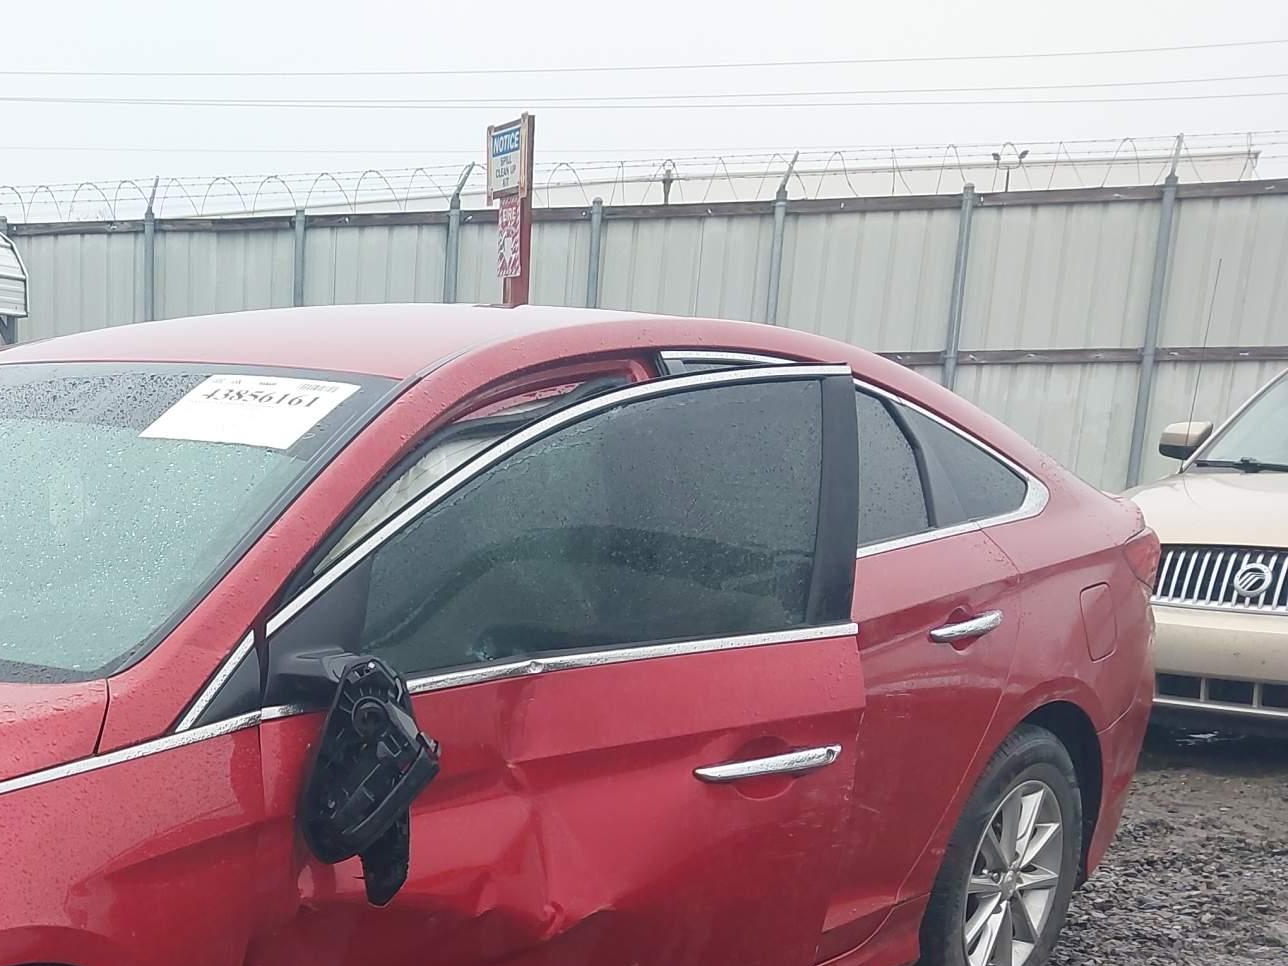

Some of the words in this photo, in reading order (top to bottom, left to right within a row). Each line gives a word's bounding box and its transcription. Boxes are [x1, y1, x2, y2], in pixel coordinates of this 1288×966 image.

[494, 131, 519, 154] NOTICE
[496, 166, 509, 178] CLEAN
[202, 388, 320, 407] 43856161
